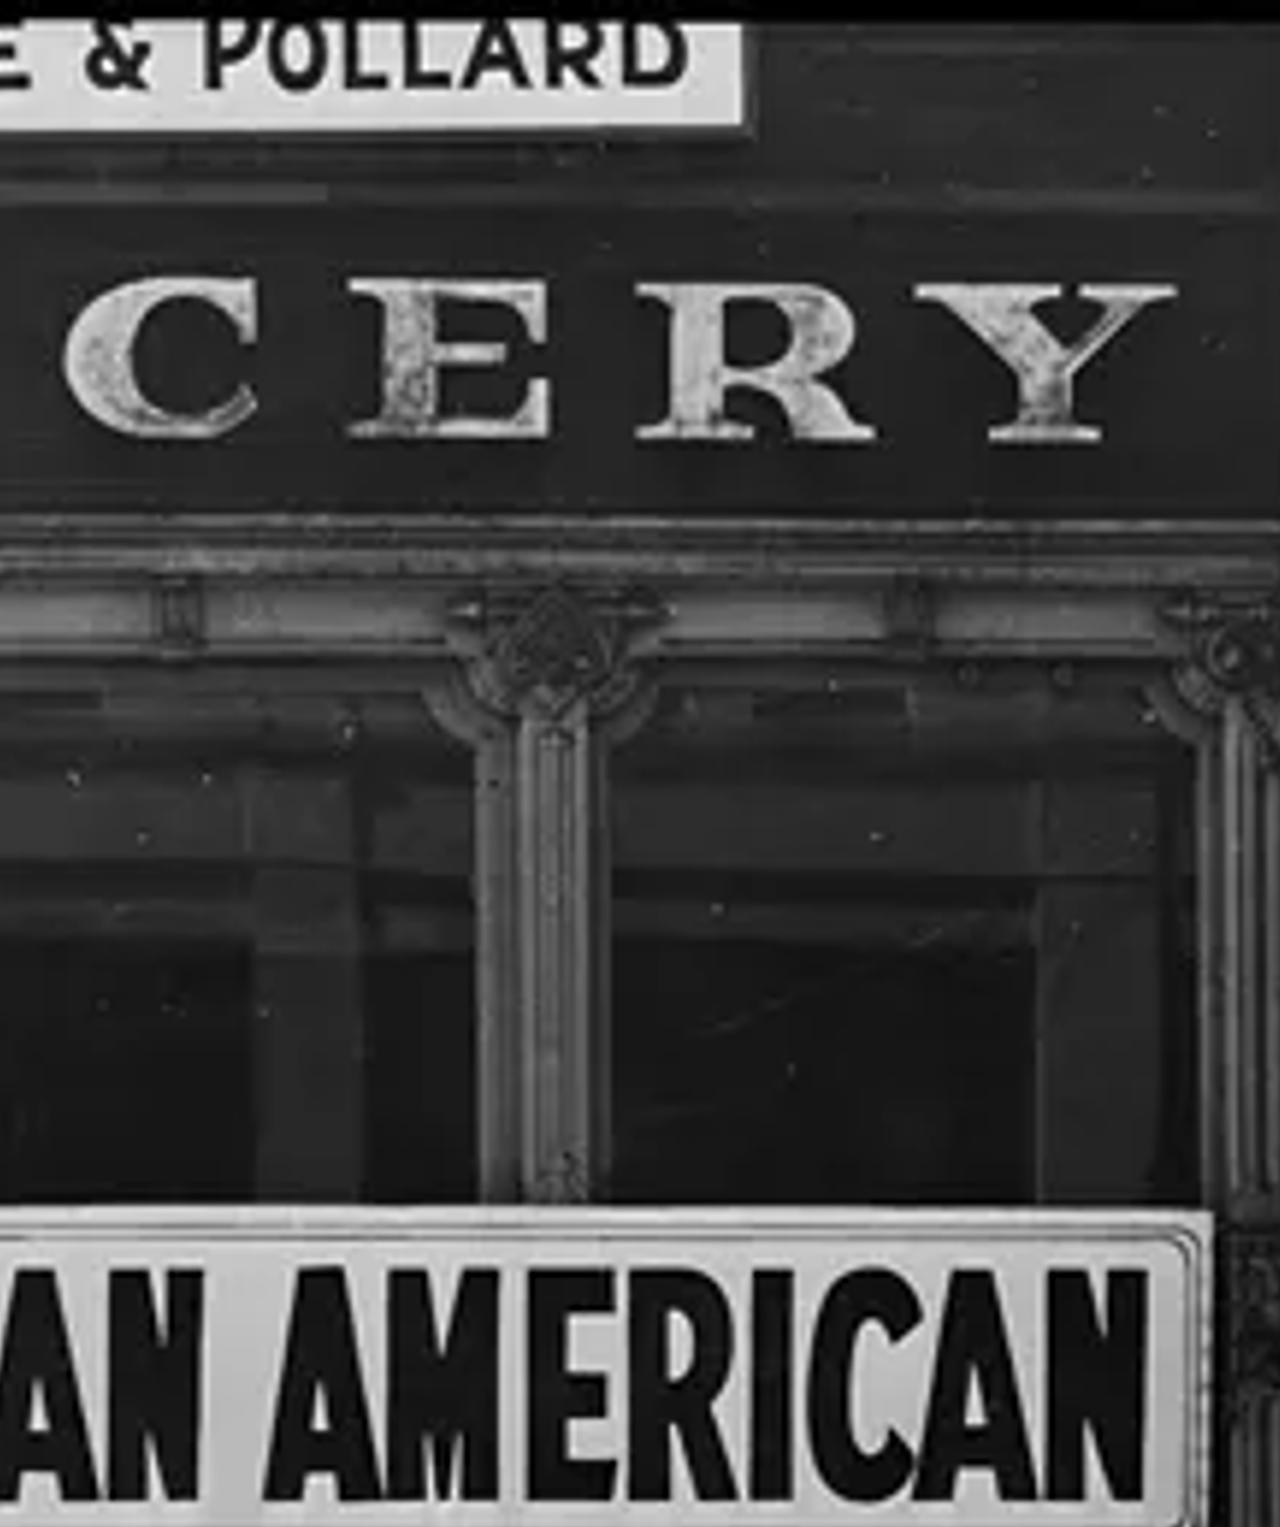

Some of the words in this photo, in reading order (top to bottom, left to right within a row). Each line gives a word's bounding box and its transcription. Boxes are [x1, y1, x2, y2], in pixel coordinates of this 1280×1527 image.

[84, 19, 152, 90] &
[202, 19, 690, 92] POLLARD
[262, 1265, 1149, 1503] AMERICAN
